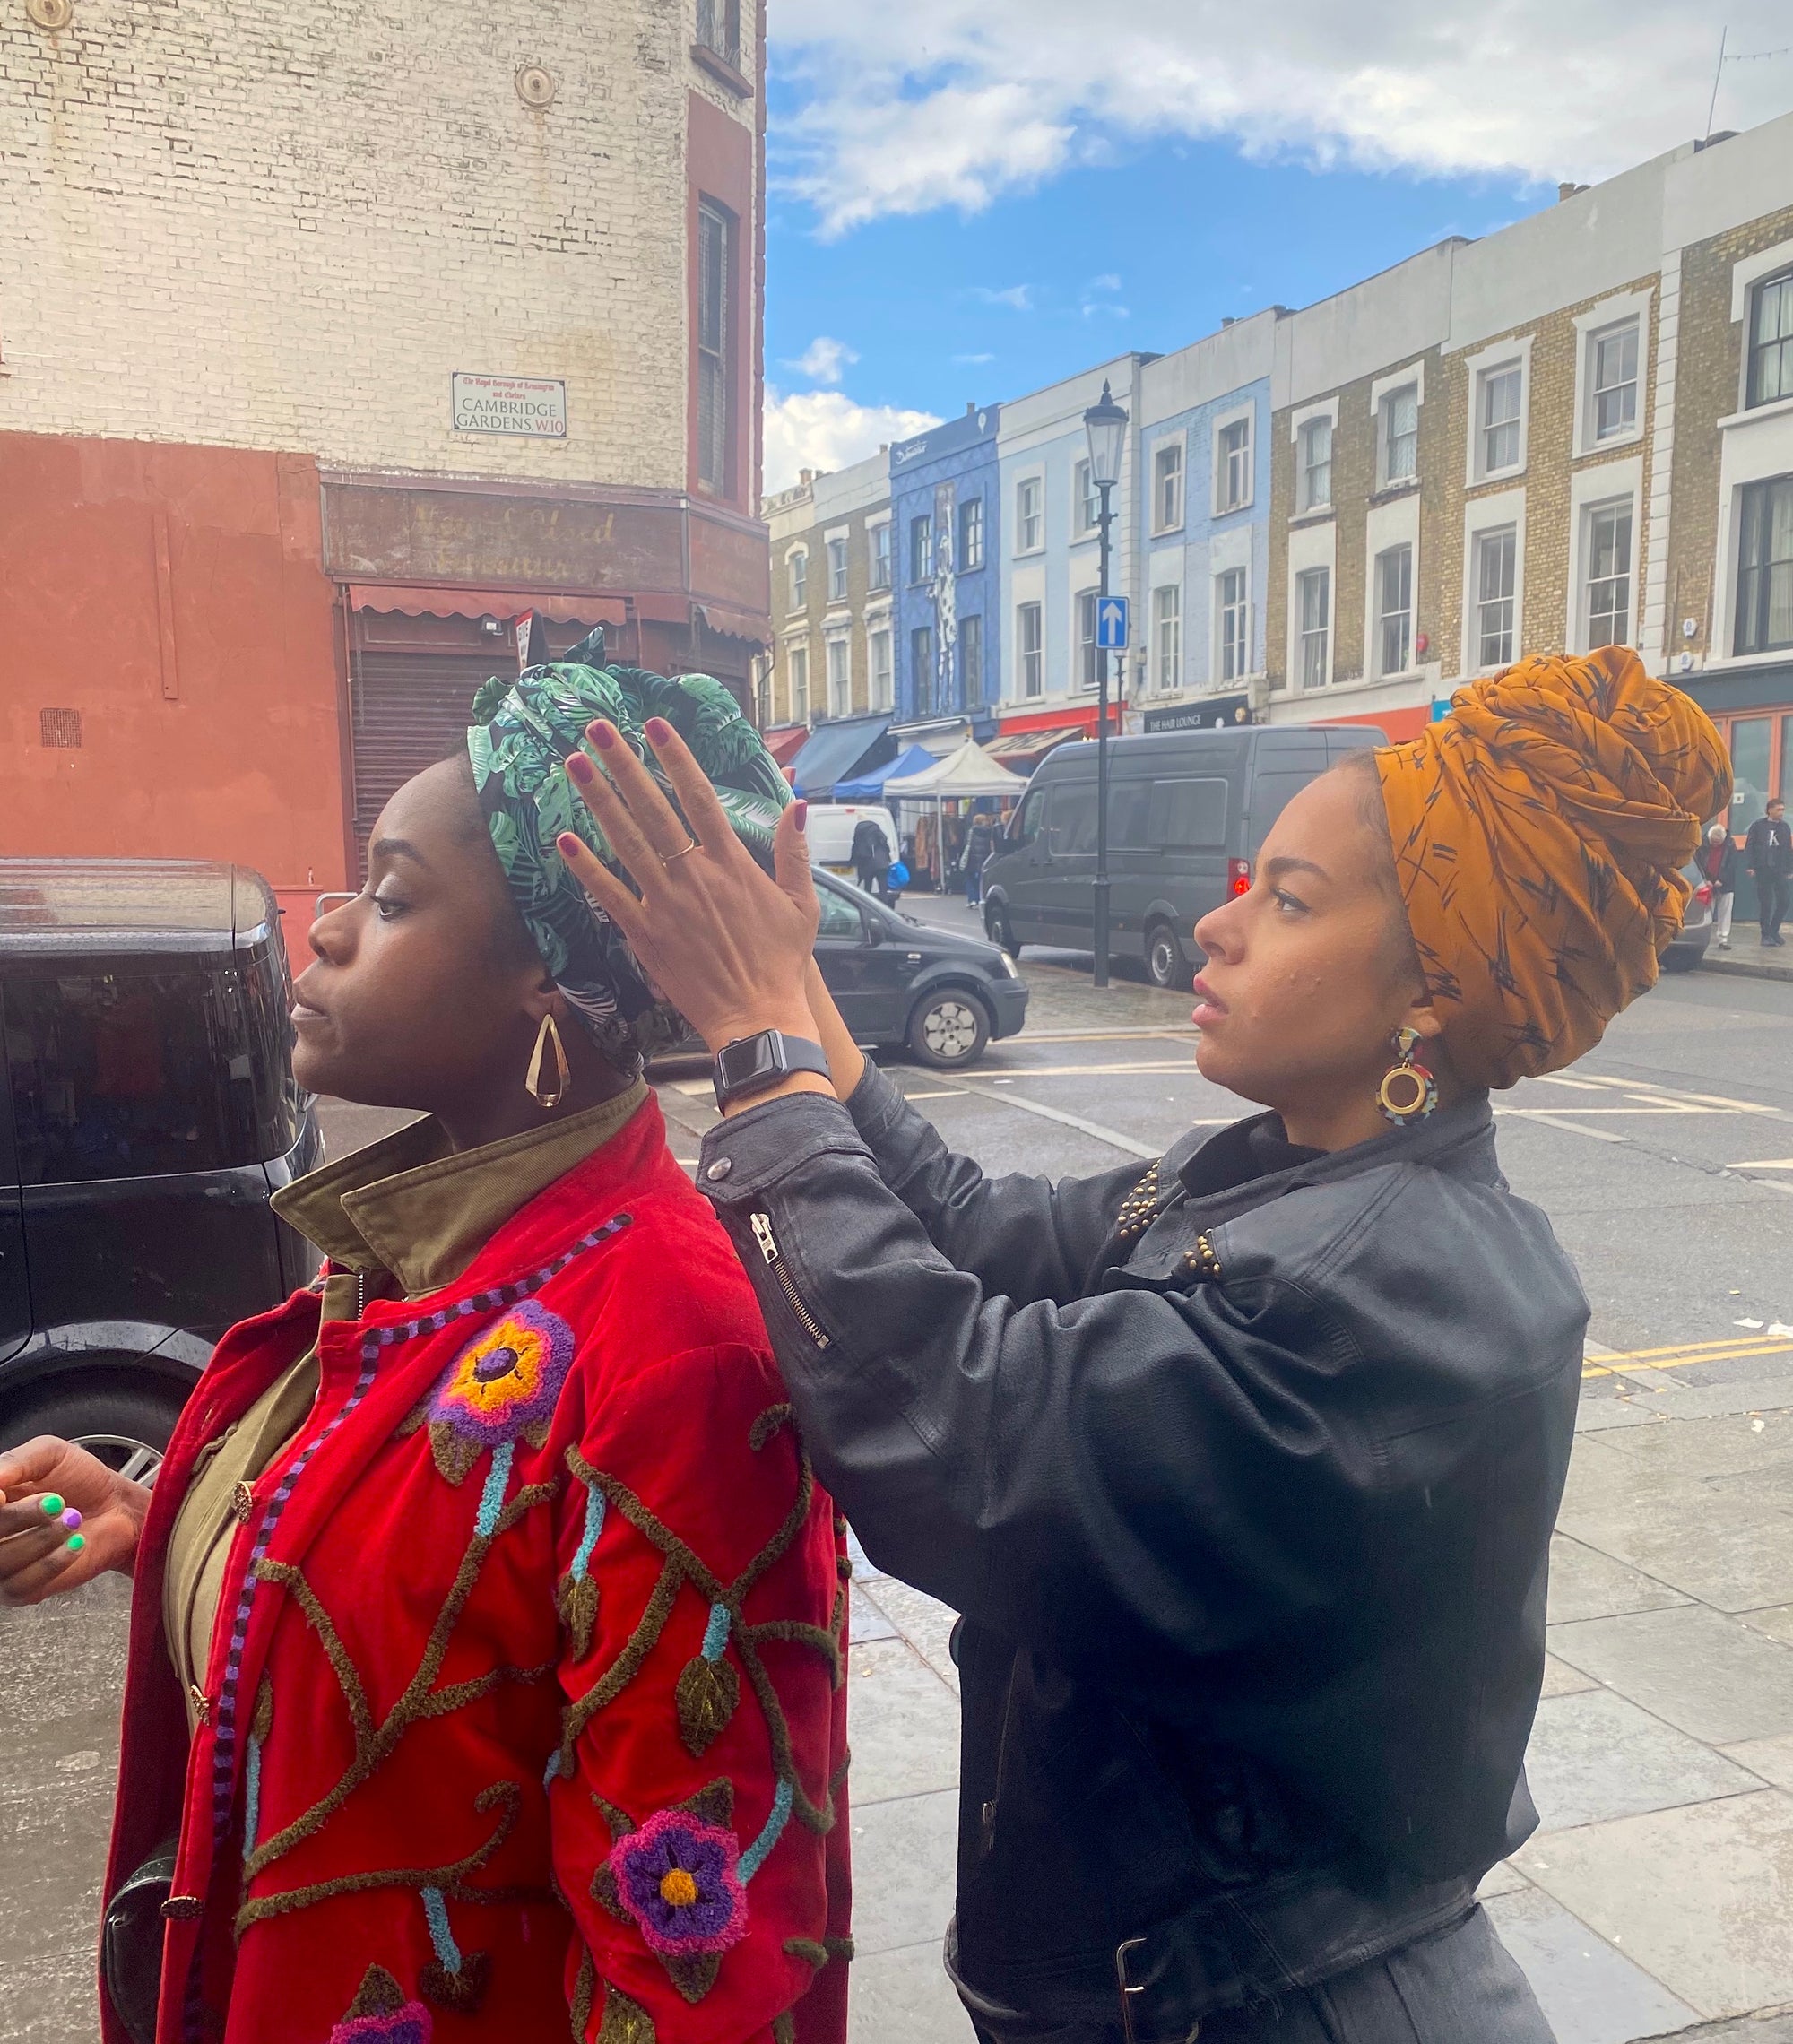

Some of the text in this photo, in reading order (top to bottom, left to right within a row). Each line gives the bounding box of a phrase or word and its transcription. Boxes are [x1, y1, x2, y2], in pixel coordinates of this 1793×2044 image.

[475, 378, 491, 387] Royal
[492, 379, 515, 389] Borough
[462, 397, 557, 417] CAMBRIDGE
[1149, 715, 1201, 732] THE HAIR LOUNGE
